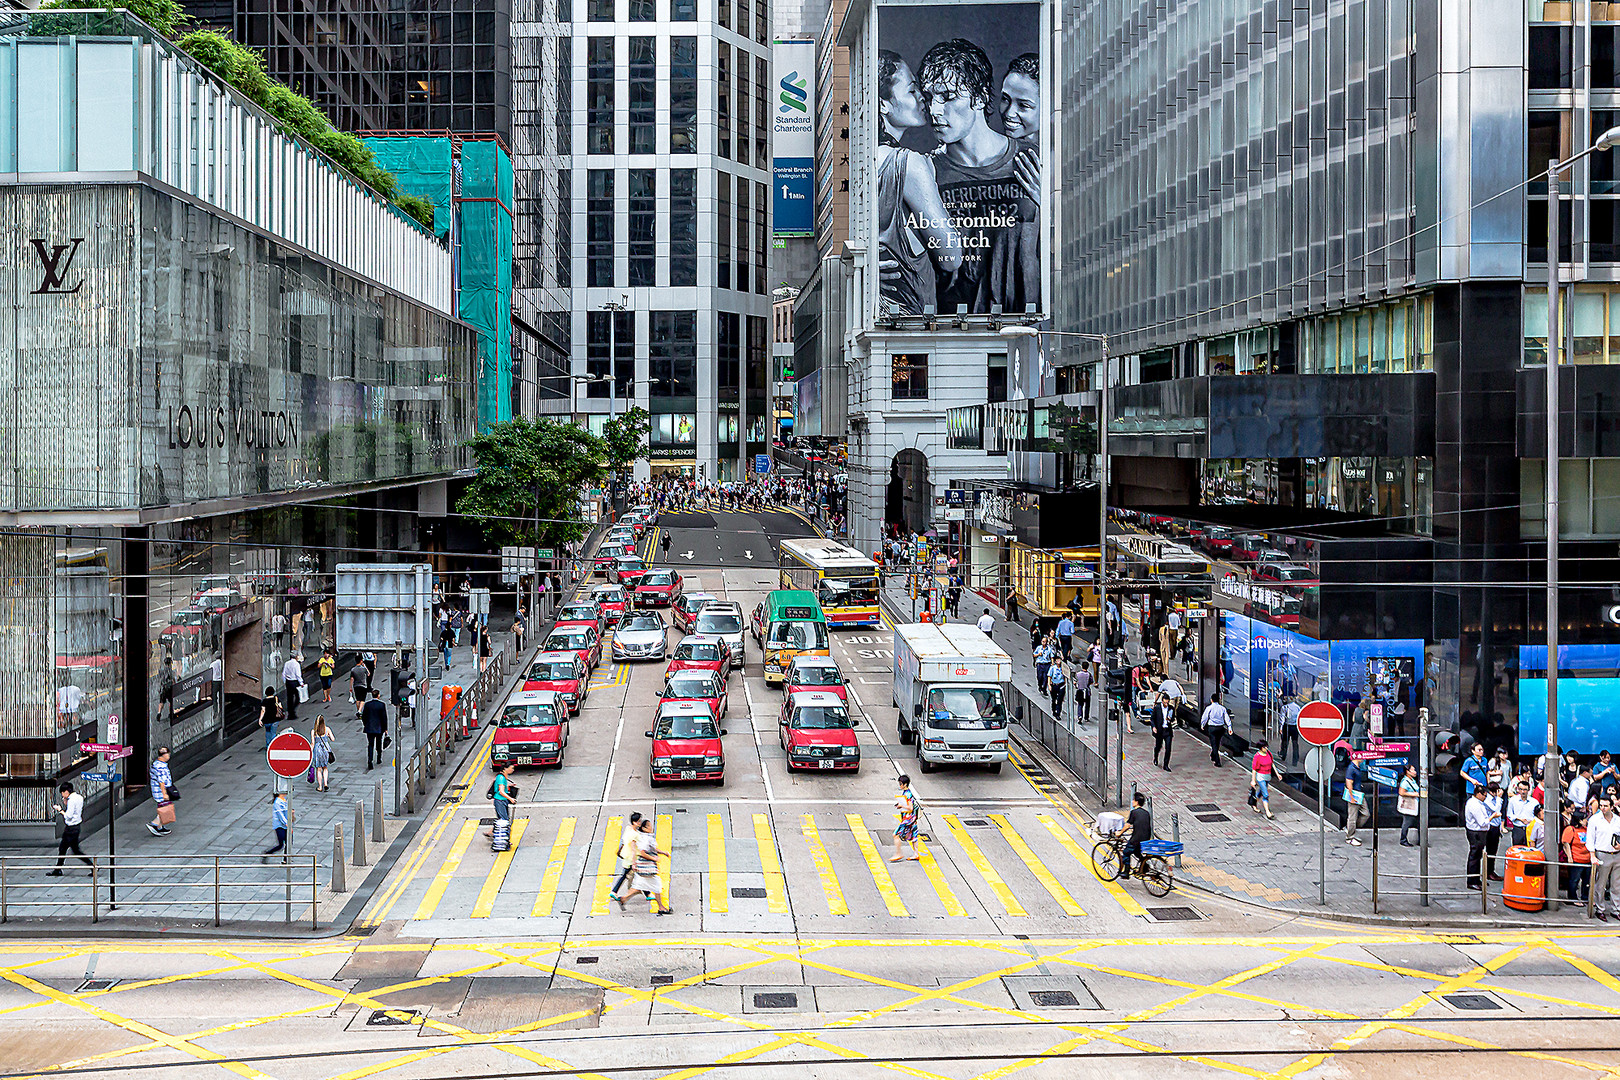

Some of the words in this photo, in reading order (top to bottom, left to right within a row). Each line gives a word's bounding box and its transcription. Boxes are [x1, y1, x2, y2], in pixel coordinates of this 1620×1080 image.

[774, 125, 812, 133] Chartered
[776, 116, 811, 124] Standard
[905, 211, 1016, 229] Abercrombie
[927, 236, 942, 249] &
[945, 230, 991, 248] Fitch
[169, 405, 225, 449] LOUIS
[232, 410, 298, 449] VUITTON
[1128, 537, 1159, 560] CANALI
[1220, 575, 1251, 600] citibank
[1247, 637, 1294, 649] citibank
[857, 649, 894, 659] US
[1349, 645, 1359, 694] Singapore
[1388, 672, 1396, 698] more
[1387, 699, 1396, 718] 720
